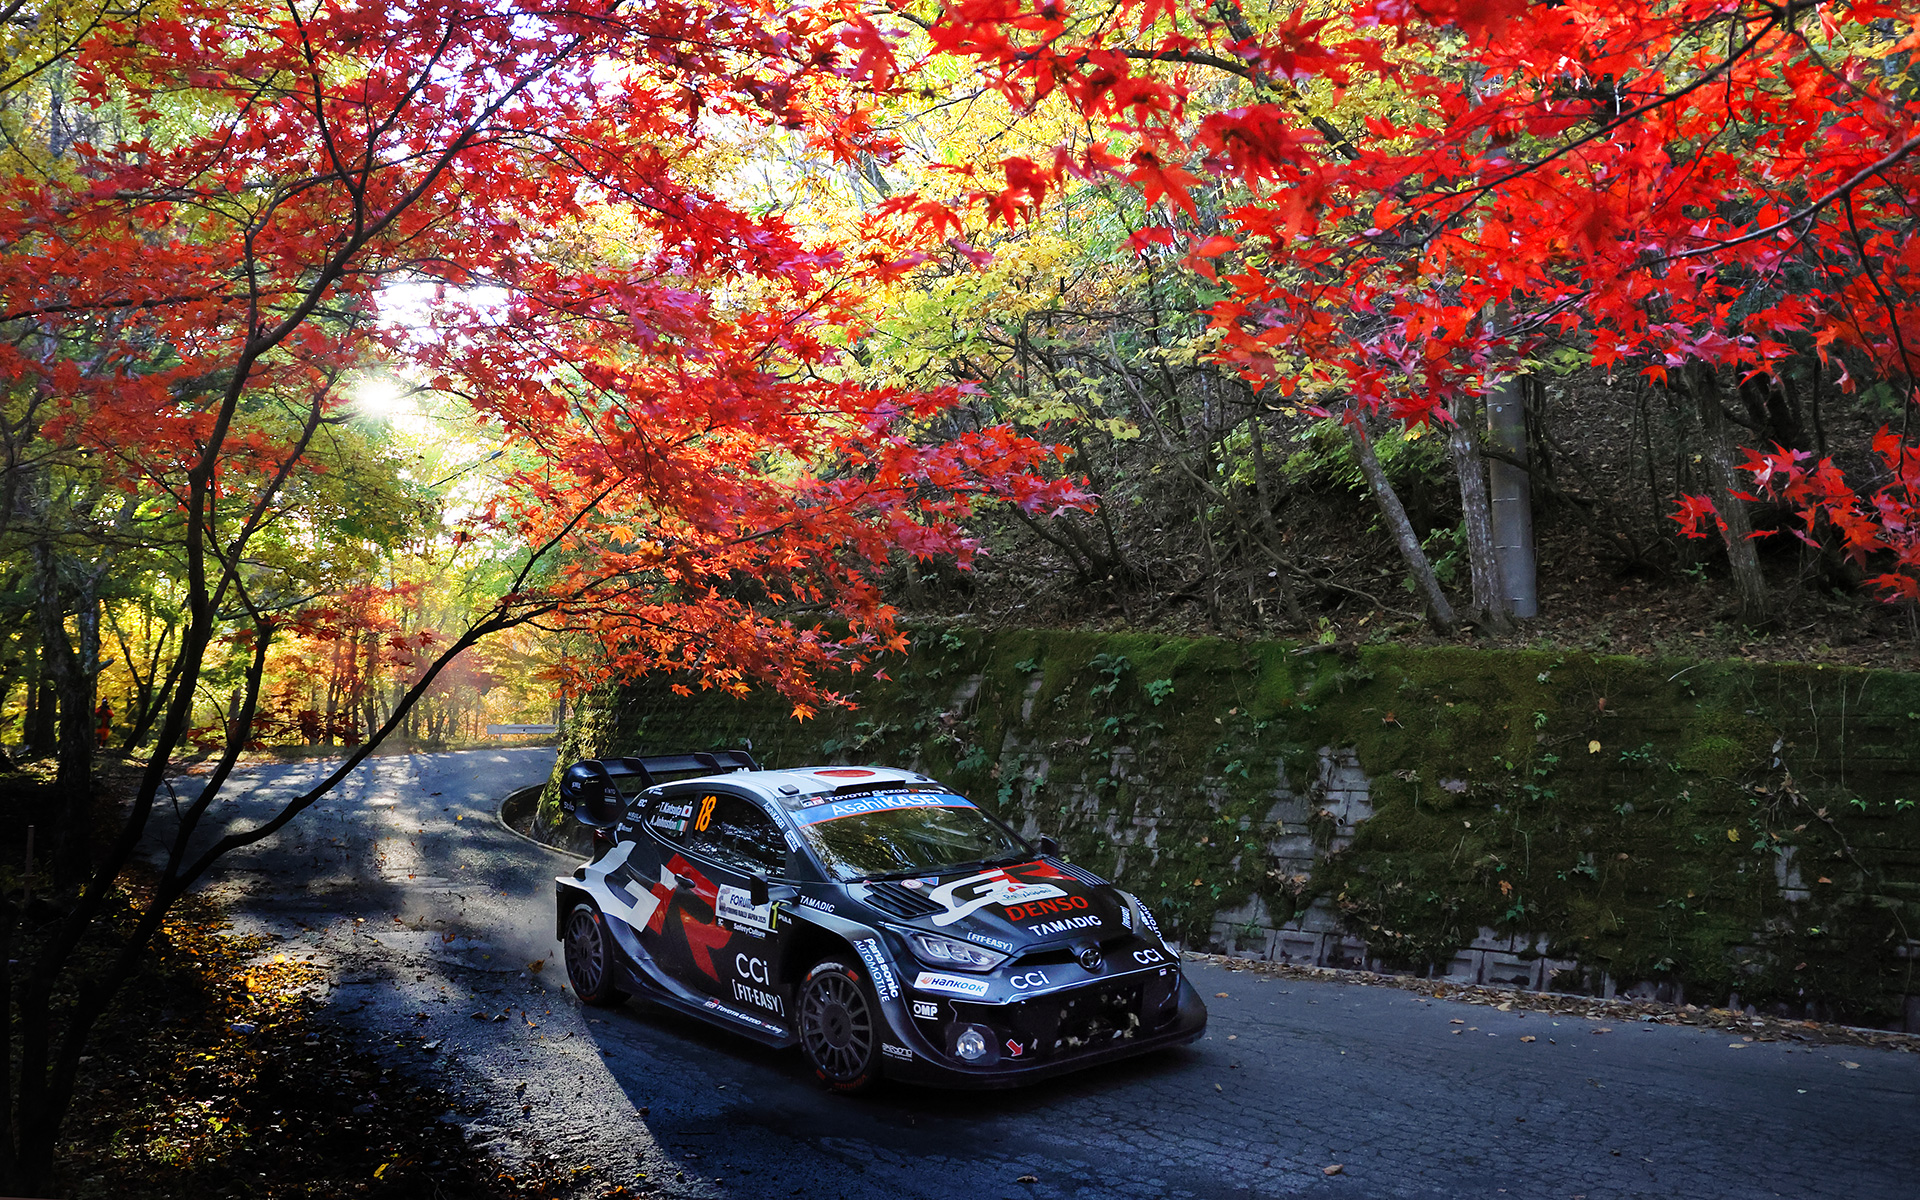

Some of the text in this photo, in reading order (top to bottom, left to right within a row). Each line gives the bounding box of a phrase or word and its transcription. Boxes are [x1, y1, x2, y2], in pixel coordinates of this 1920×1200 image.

[826, 790, 870, 802] TOYOTA
[872, 787, 909, 797] GAZOO
[832, 794, 945, 816] AsahiKASEI
[694, 796, 717, 832] 18
[800, 895, 835, 913] TAMADIC
[1004, 895, 1089, 922] DENSO
[1028, 915, 1103, 937] TAMADIC
[1129, 893, 1163, 940] AUTOMOTIV
[853, 940, 890, 1003] AUTOMOTIVE
[864, 938, 899, 998] Panasonic
[1009, 970, 1051, 990] CCi
[913, 1003, 938, 1017] OMP
